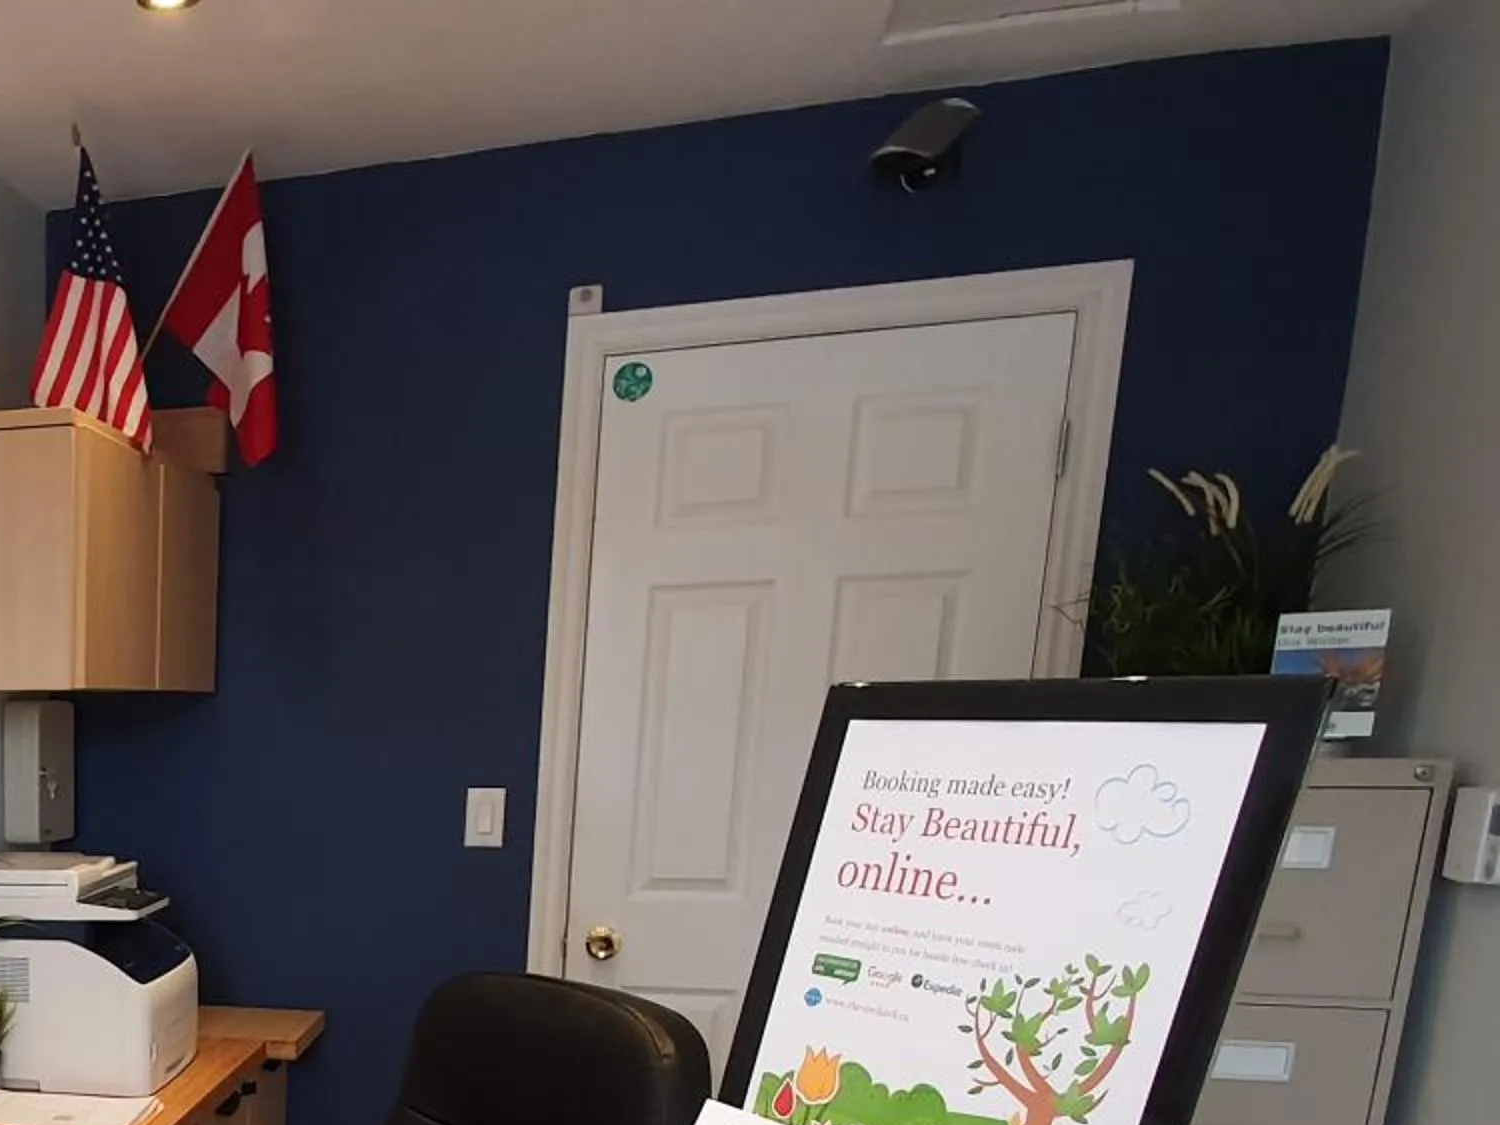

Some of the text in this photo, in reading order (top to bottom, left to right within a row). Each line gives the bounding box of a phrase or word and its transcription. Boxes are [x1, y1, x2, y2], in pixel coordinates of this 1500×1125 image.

[862, 769, 1071, 805] Booking made easy!
[851, 804, 1082, 858] Stay Beautiful,
[837, 852, 992, 905] online...
[868, 965, 902, 983] Google
[923, 978, 963, 998] Expedia
